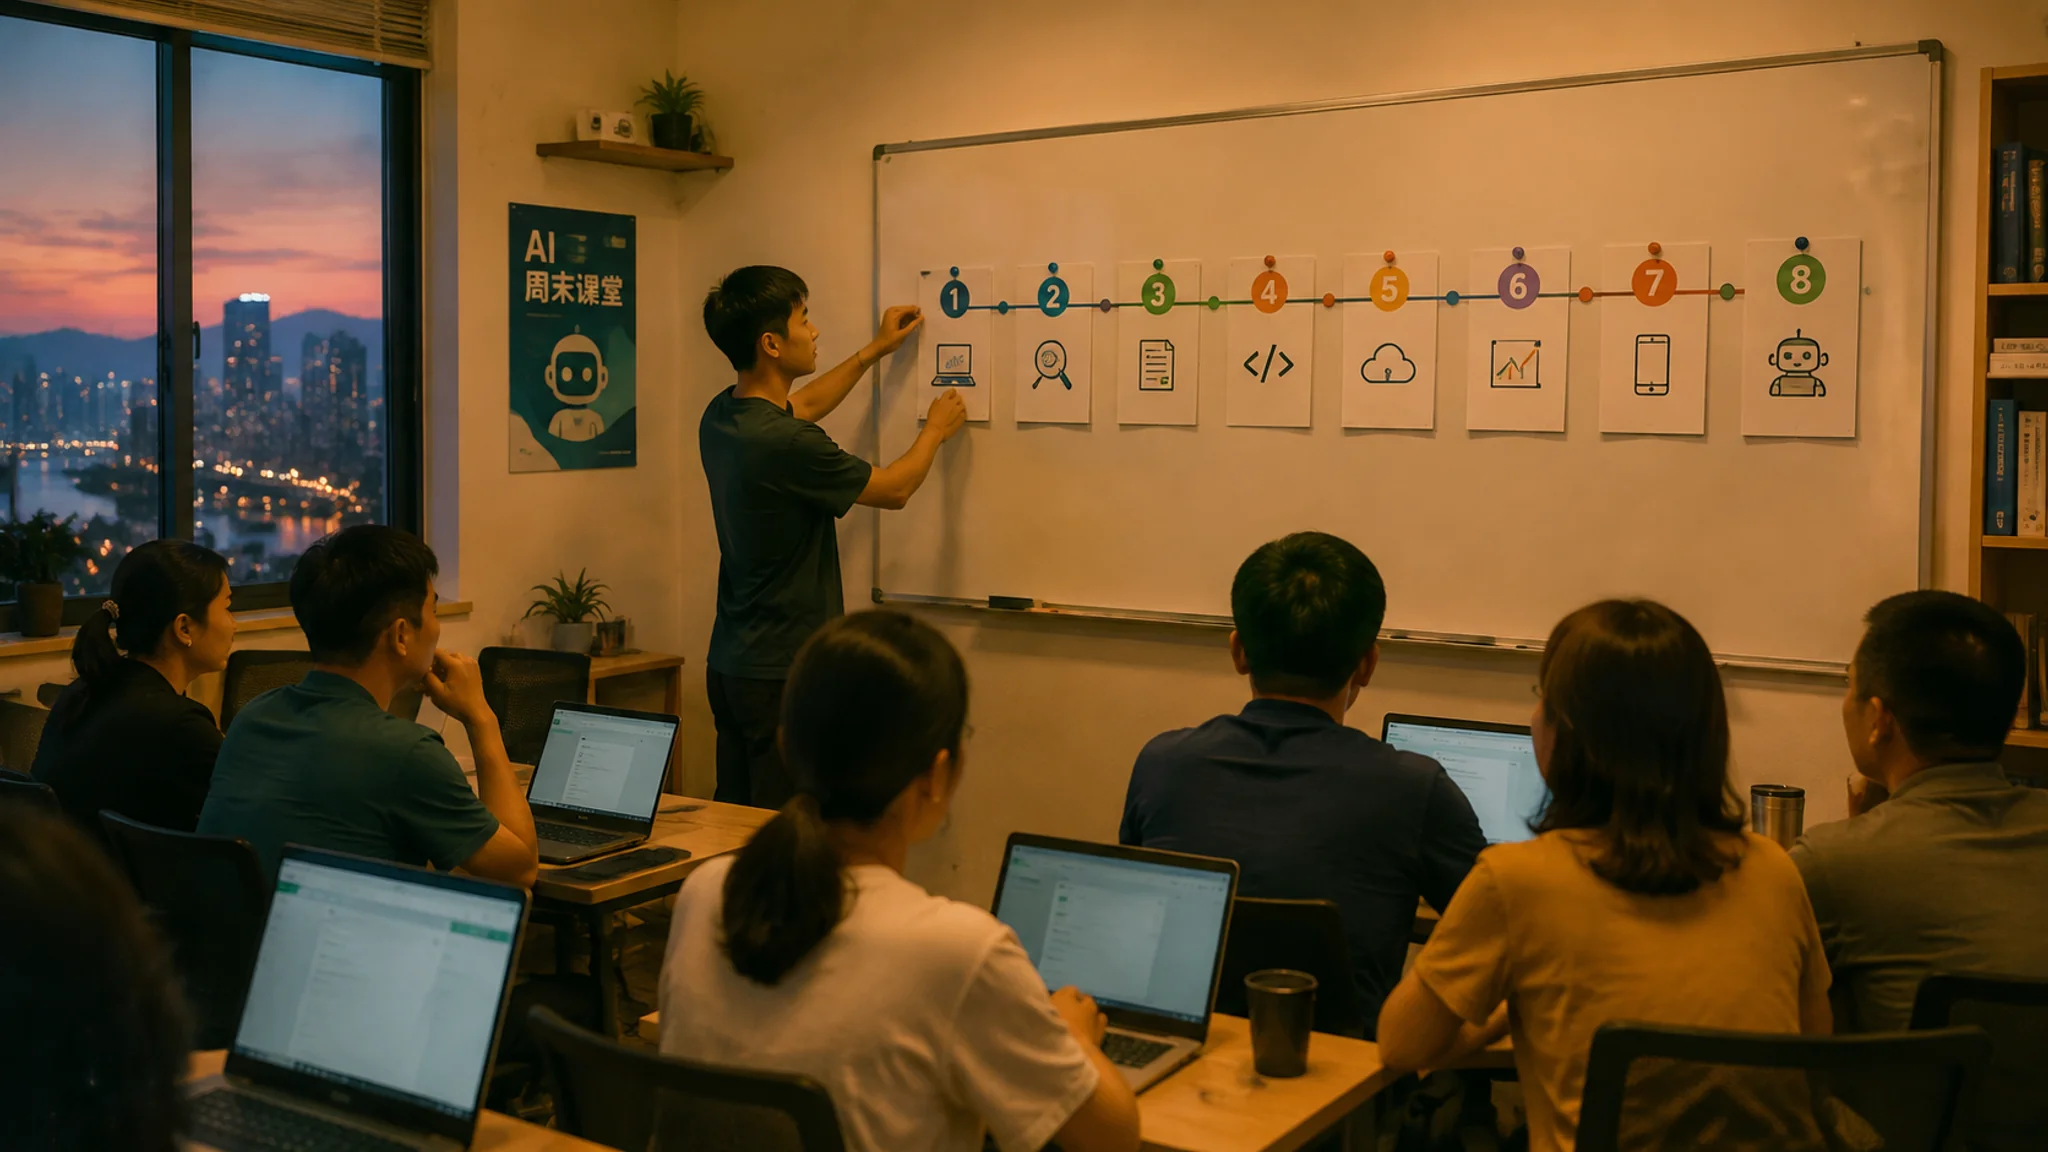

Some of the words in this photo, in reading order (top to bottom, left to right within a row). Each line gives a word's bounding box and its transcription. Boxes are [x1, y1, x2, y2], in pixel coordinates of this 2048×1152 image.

[525, 229, 555, 263] AI
[525, 270, 623, 307] 周末课堂
[1260, 279, 1278, 304] 4
[1381, 276, 1398, 302] 5
[1510, 273, 1528, 300] 6
[1645, 270, 1664, 297] 7
[1790, 265, 1812, 294] 8
[949, 287, 959, 310] 1
[1046, 284, 1061, 308] 2
[1151, 283, 1165, 307] 3
